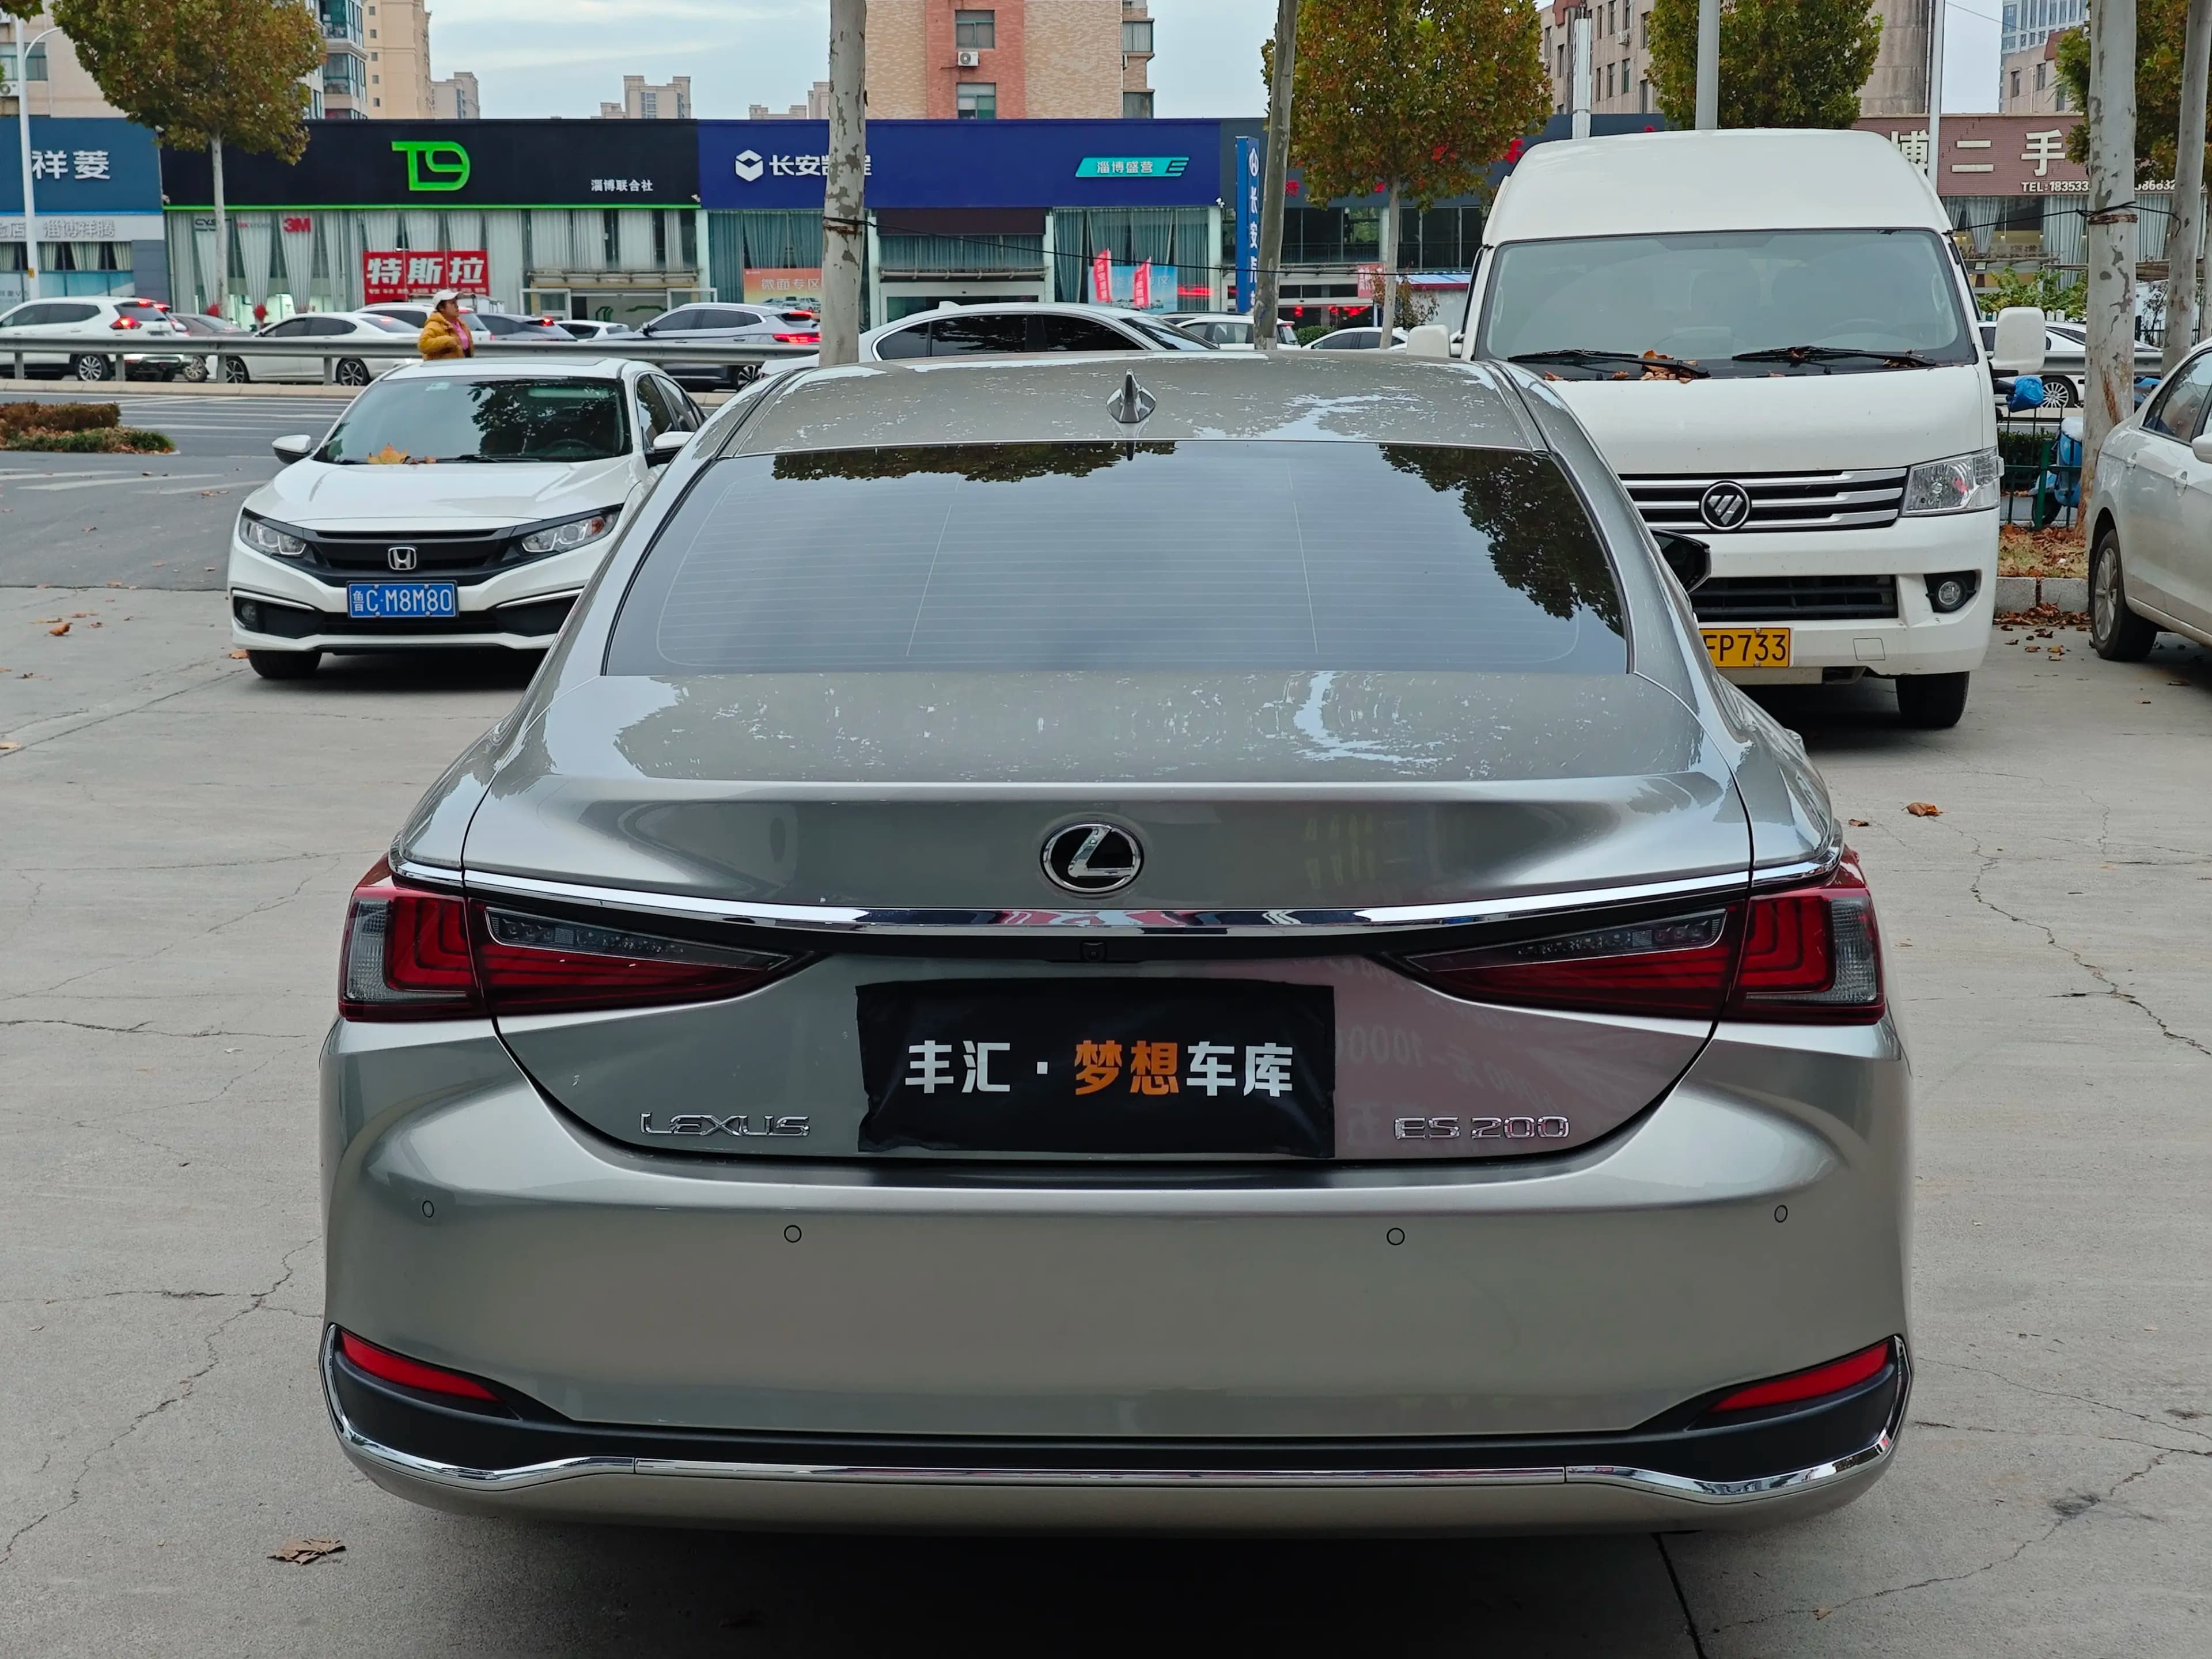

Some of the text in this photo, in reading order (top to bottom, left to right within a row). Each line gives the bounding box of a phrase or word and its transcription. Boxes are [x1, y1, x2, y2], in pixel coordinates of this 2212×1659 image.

[32, 150, 111, 180] 祥菱
[1097, 161, 1153, 173] 淄博盛营
[591, 179, 653, 192] 淄博联合社
[2021, 180, 2089, 192] TEL:183533
[284, 217, 311, 232] 3M
[367, 257, 484, 285] 特斯拉
[762, 278, 821, 290] 微面专区
[639, 1111, 810, 1136] LEXUS
[1394, 1115, 1571, 1139] ES 200
